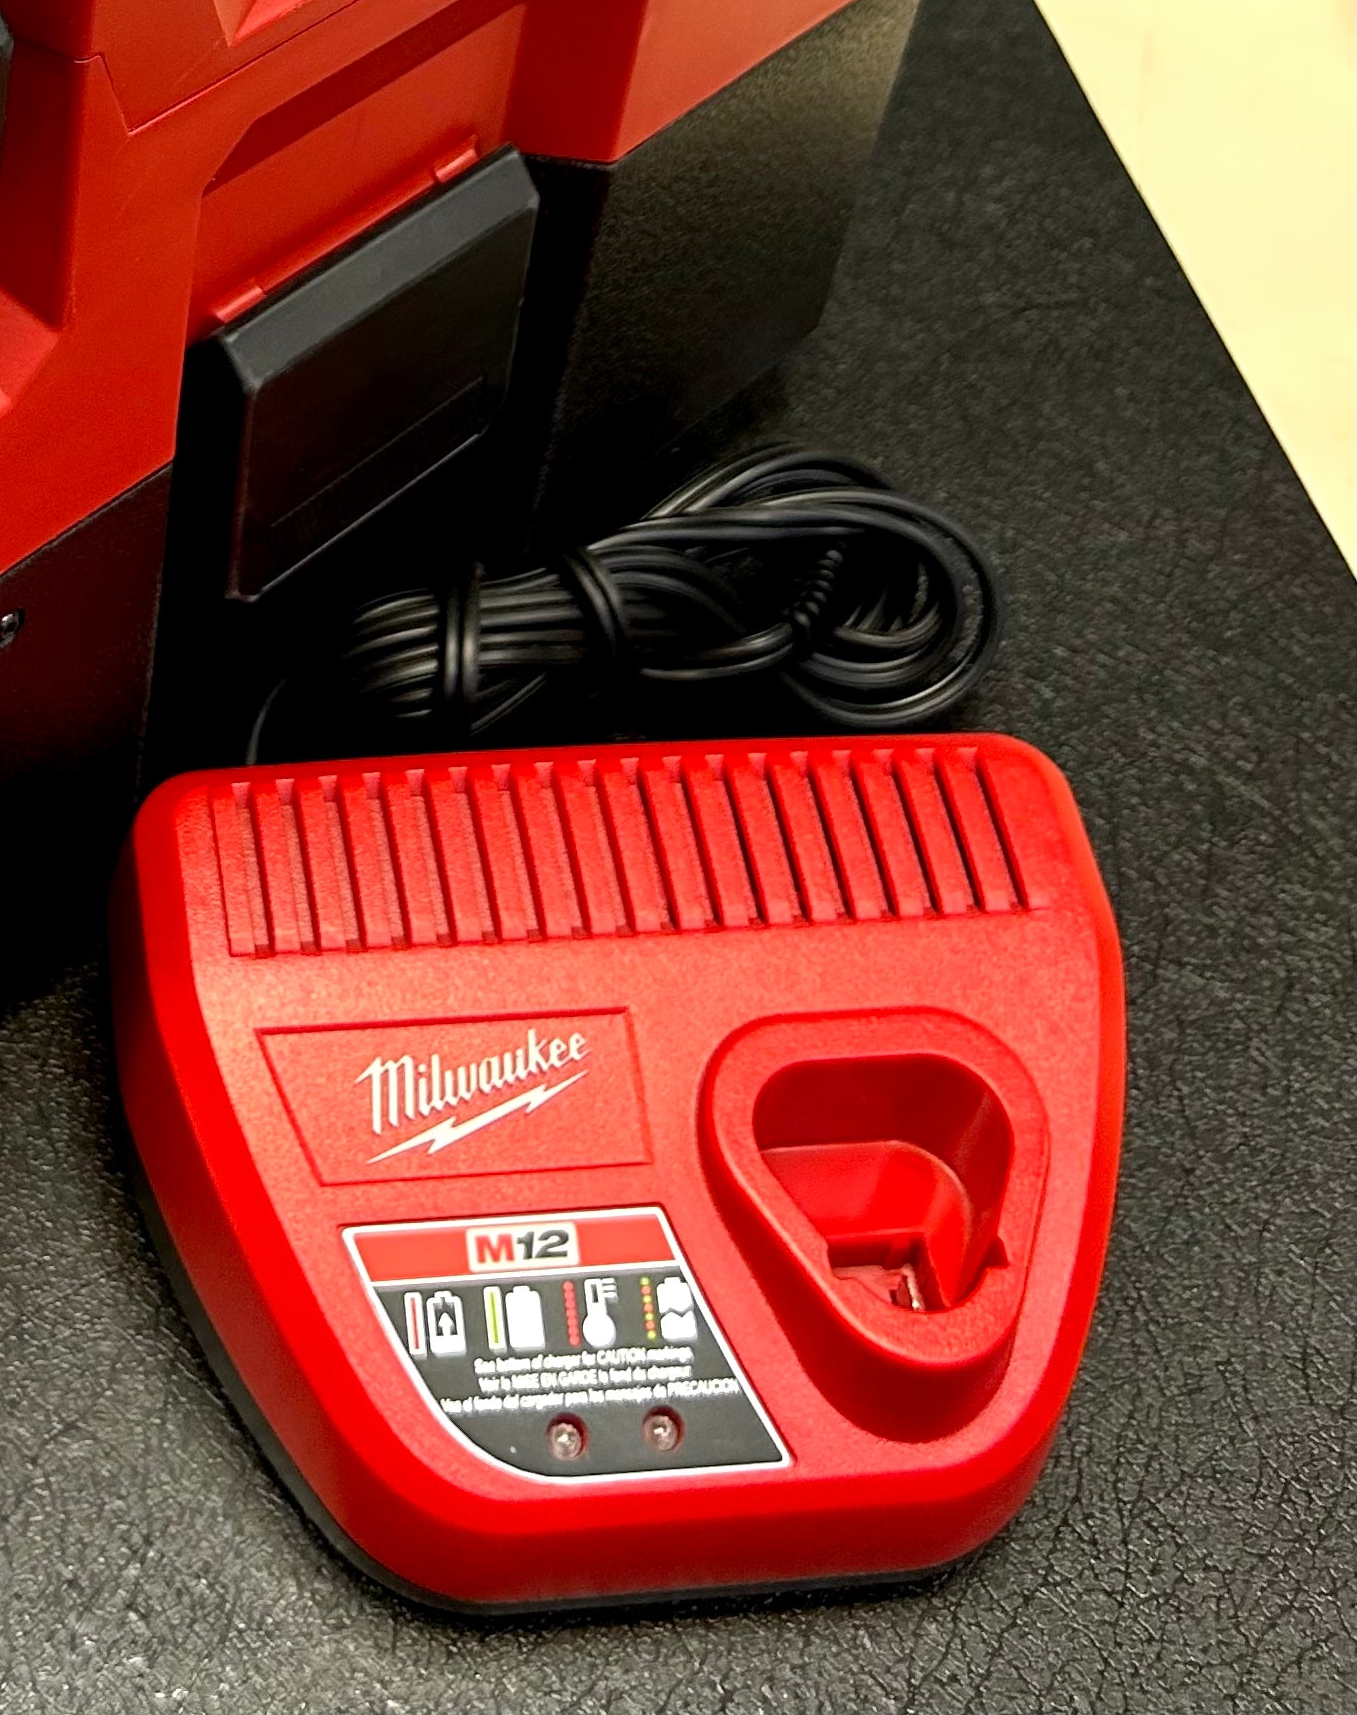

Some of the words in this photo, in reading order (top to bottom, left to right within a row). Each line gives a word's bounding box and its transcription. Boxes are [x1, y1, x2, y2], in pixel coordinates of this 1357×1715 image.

[354, 1027, 592, 1135] Milwaukee
[474, 1228, 570, 1265] M12
[596, 1347, 647, 1365] CAUTION
